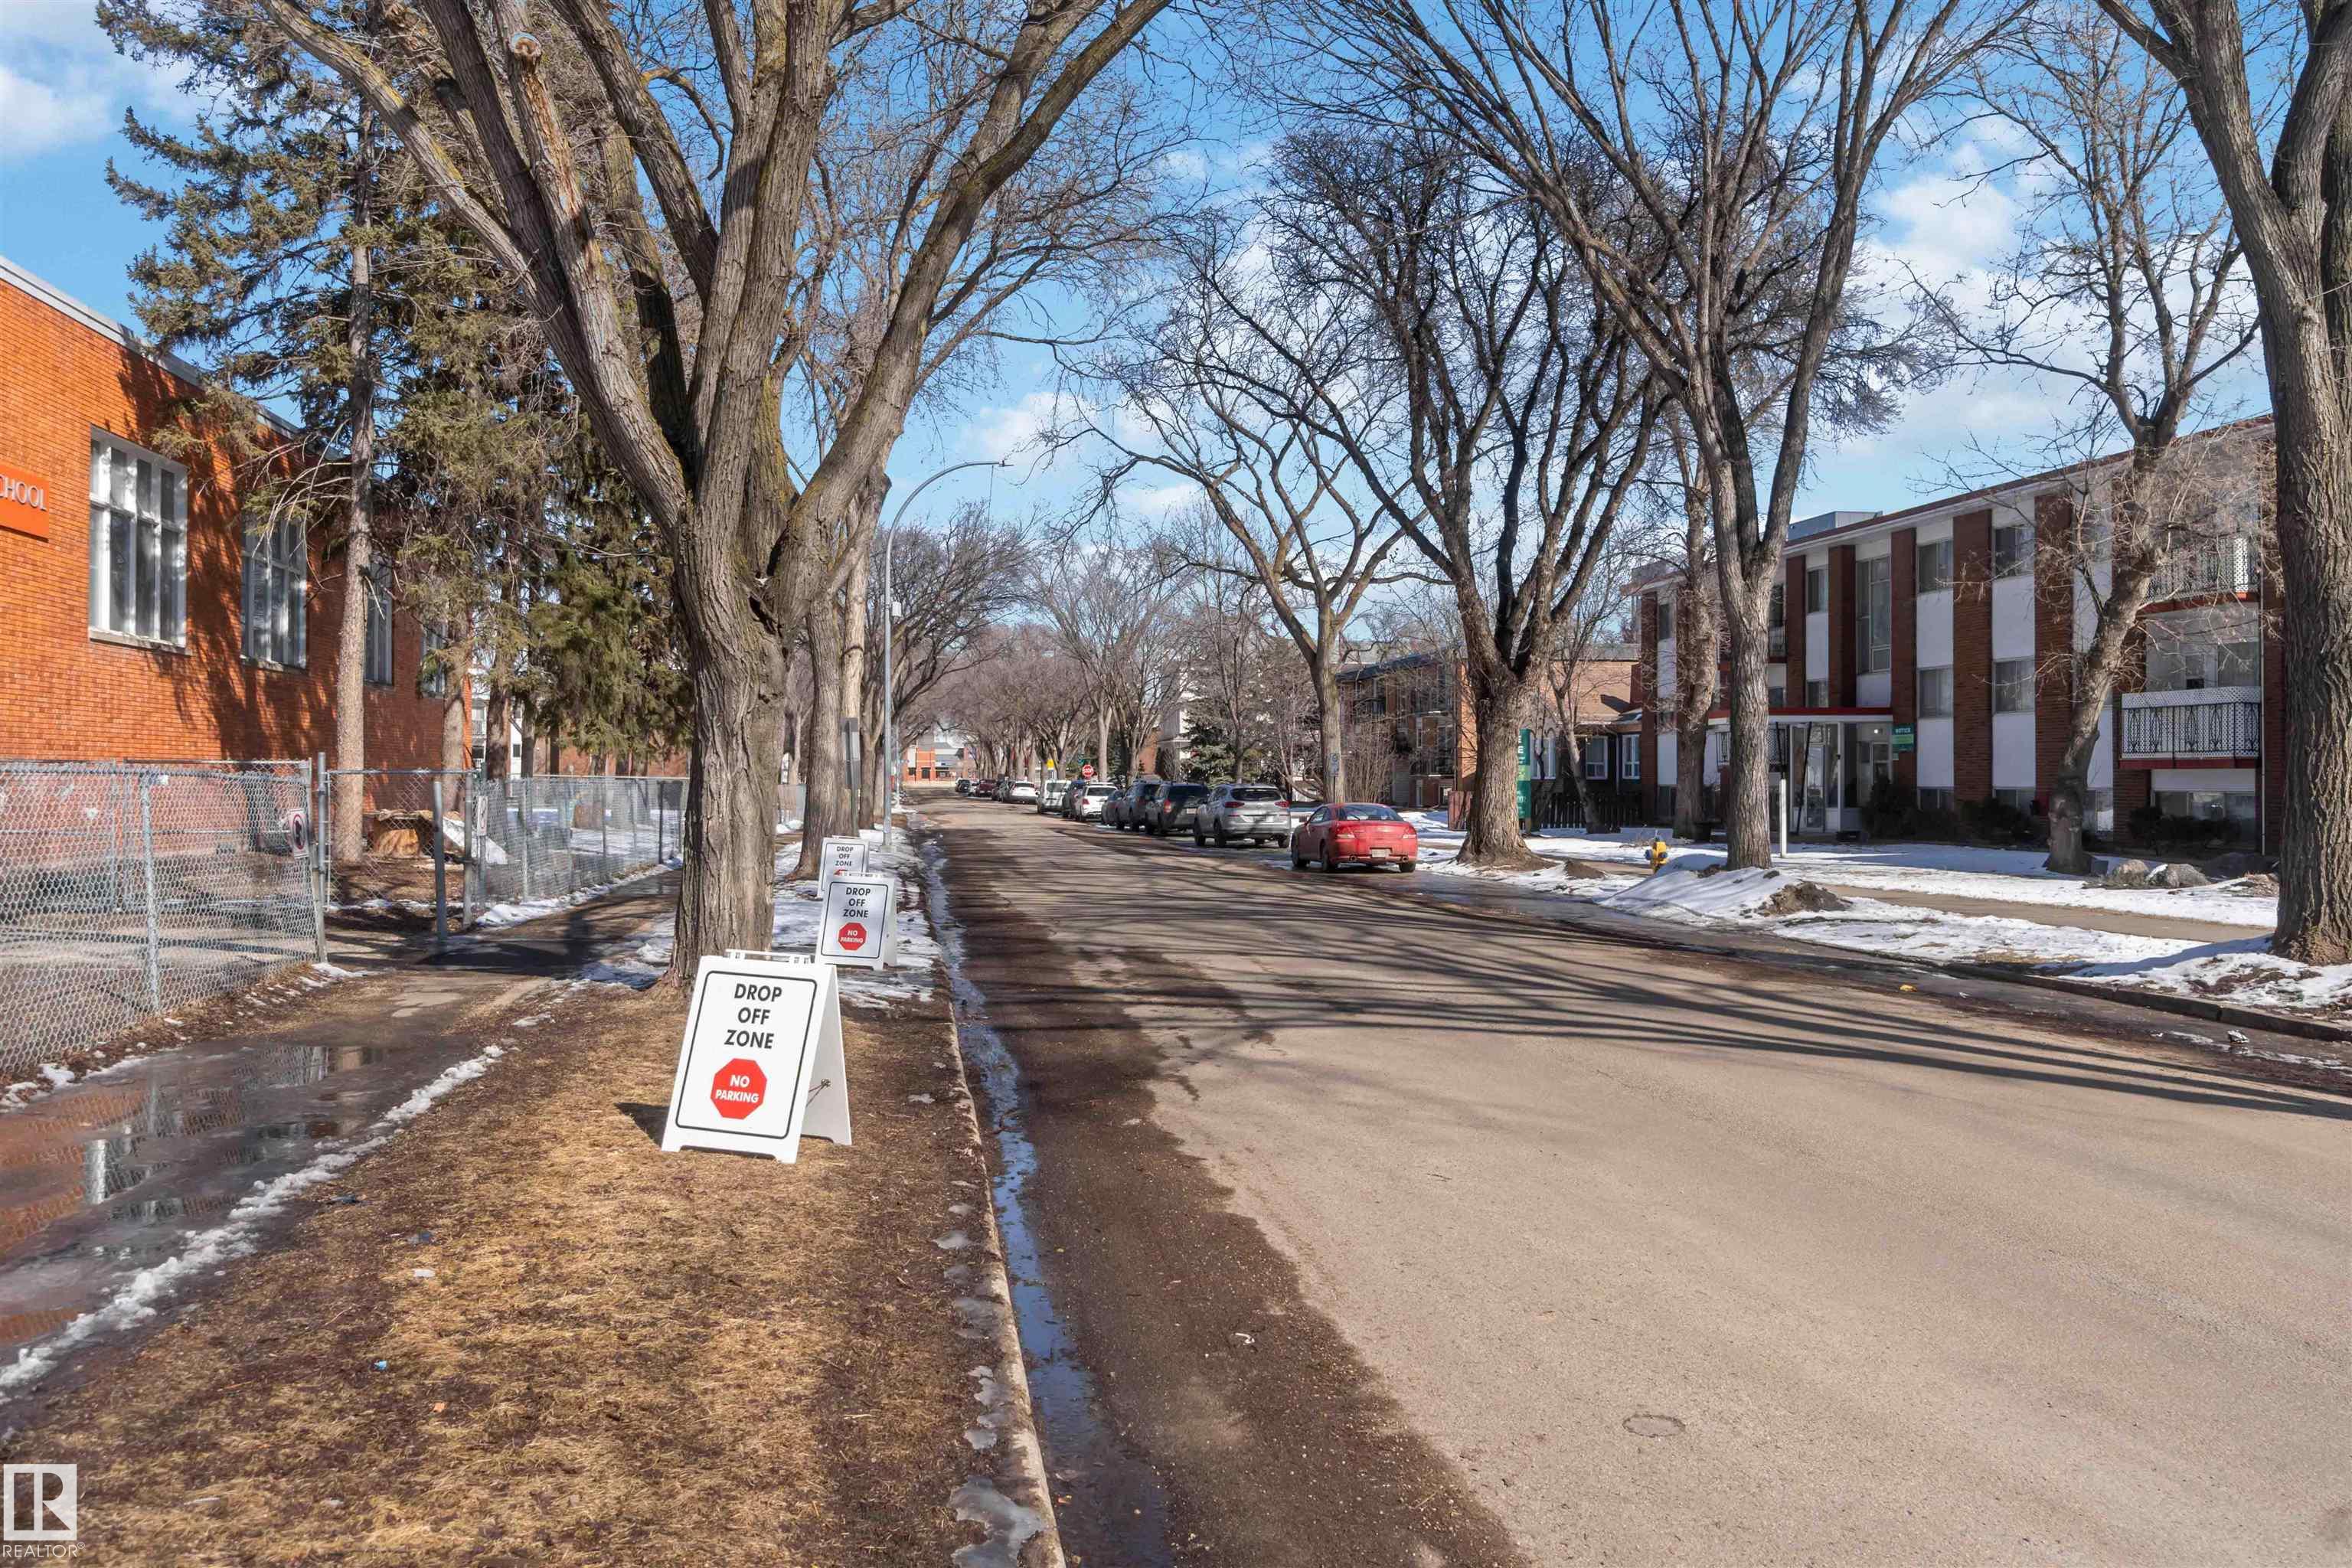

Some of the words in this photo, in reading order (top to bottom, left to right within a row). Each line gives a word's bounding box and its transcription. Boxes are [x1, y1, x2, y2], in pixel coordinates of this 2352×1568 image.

[845, 887, 871, 896] DROP
[848, 898, 866, 906] OFF
[843, 909, 869, 918] ZONE
[734, 983, 782, 1002] DROP
[737, 1007, 771, 1025] OFF
[724, 1029, 775, 1050] ZONE
[730, 1074, 750, 1088] NO
[715, 1089, 760, 1103] PARKING
